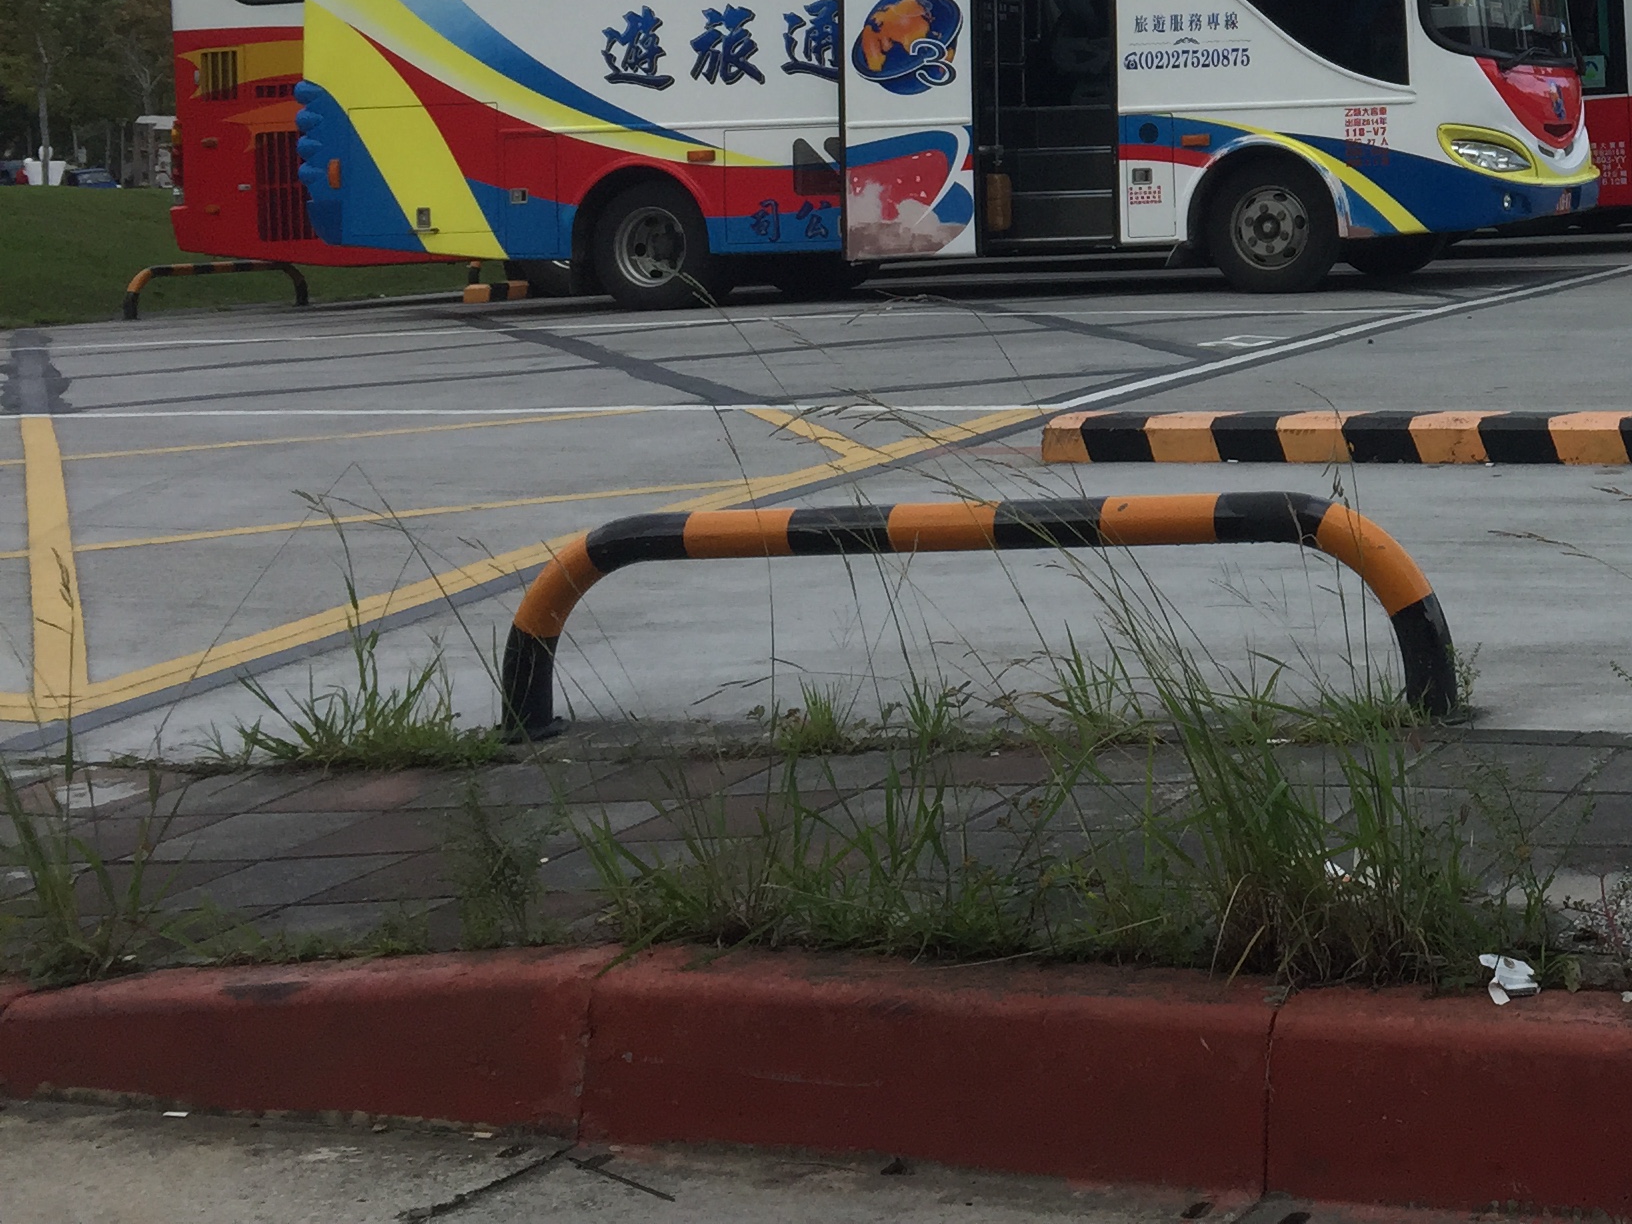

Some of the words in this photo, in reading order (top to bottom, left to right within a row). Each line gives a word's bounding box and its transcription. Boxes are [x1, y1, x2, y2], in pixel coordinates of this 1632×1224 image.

[1134, 12, 1239, 33] 旅遊服務專線
[1138, 48, 1251, 70] (02)27520875
